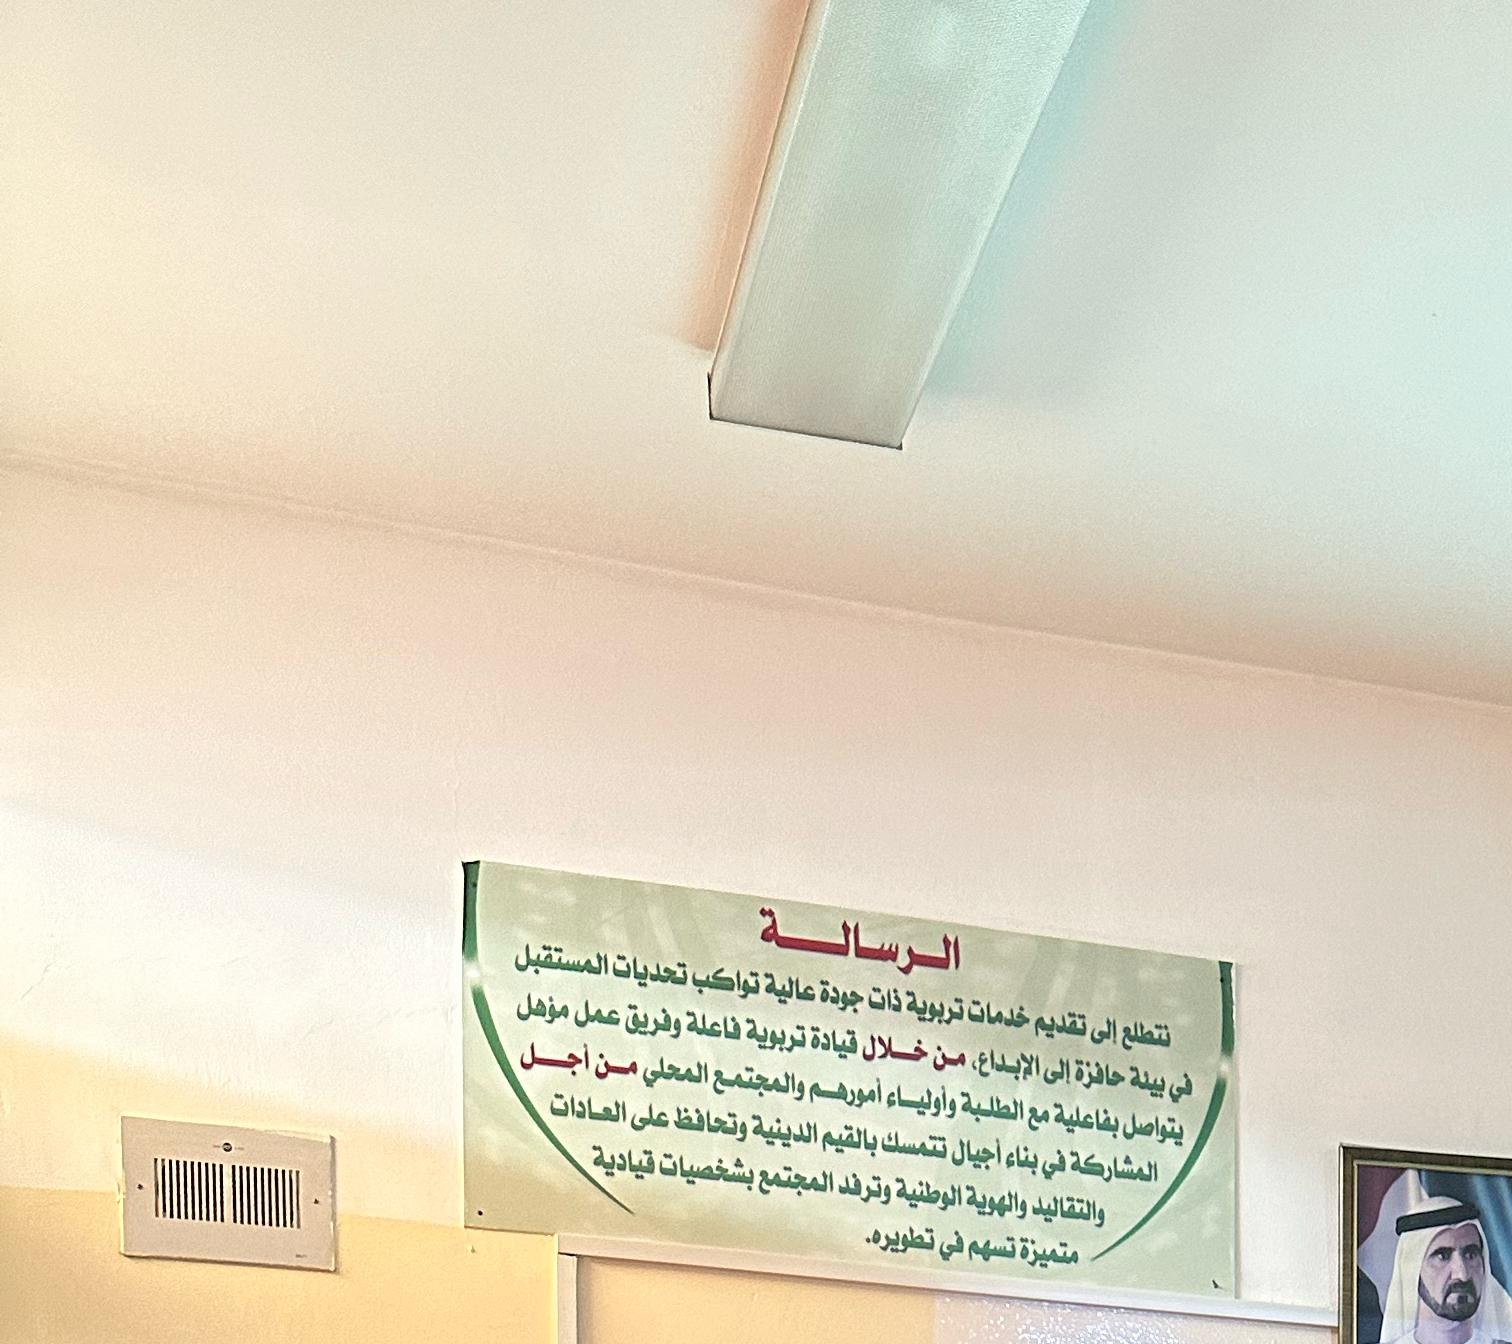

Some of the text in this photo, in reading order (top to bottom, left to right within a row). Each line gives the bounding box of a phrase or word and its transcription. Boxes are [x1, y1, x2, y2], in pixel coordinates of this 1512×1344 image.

[760, 907, 960, 974] الرسالة
[514, 943, 1171, 1050] نتطلع إلى تقديم خدمات تربوية ذات جودة عالية تواكب تحديات المستقبل
[516, 992, 569, 1024] مؤهل
[574, 999, 621, 1029] عمل
[624, 1003, 682, 1039] وفريق
[686, 1010, 742, 1040] فاعلة
[746, 1017, 807, 1051] تربوية
[810, 1026, 858, 1059] قيادة
[862, 1034, 928, 1062] خلال
[933, 1045, 967, 1071] من
[1043, 1059, 1070, 1085] إلى
[1075, 1060, 1125, 1090] حافزة
[1129, 1065, 1166, 1098] بيئة
[1169, 1073, 1193, 1102] في
[520, 1042, 1185, 1147] يتواصل بفاعلية مع الطلبة وأولياء أمورهم والمجتمع المحلي من أجل
[549, 1092, 1158, 1182] المشاركة في بناء أجيال تتمسك بالقيم الدينية وتحافظ على العادات
[592, 1145, 1106, 1227] والتقاليد والهوية الوطنية وترفد المجتمع بشخصيات قيادية
[939, 1230, 964, 1261] في
[968, 1236, 1016, 1261] تسهم
[1020, 1237, 1079, 1268] متميزة
